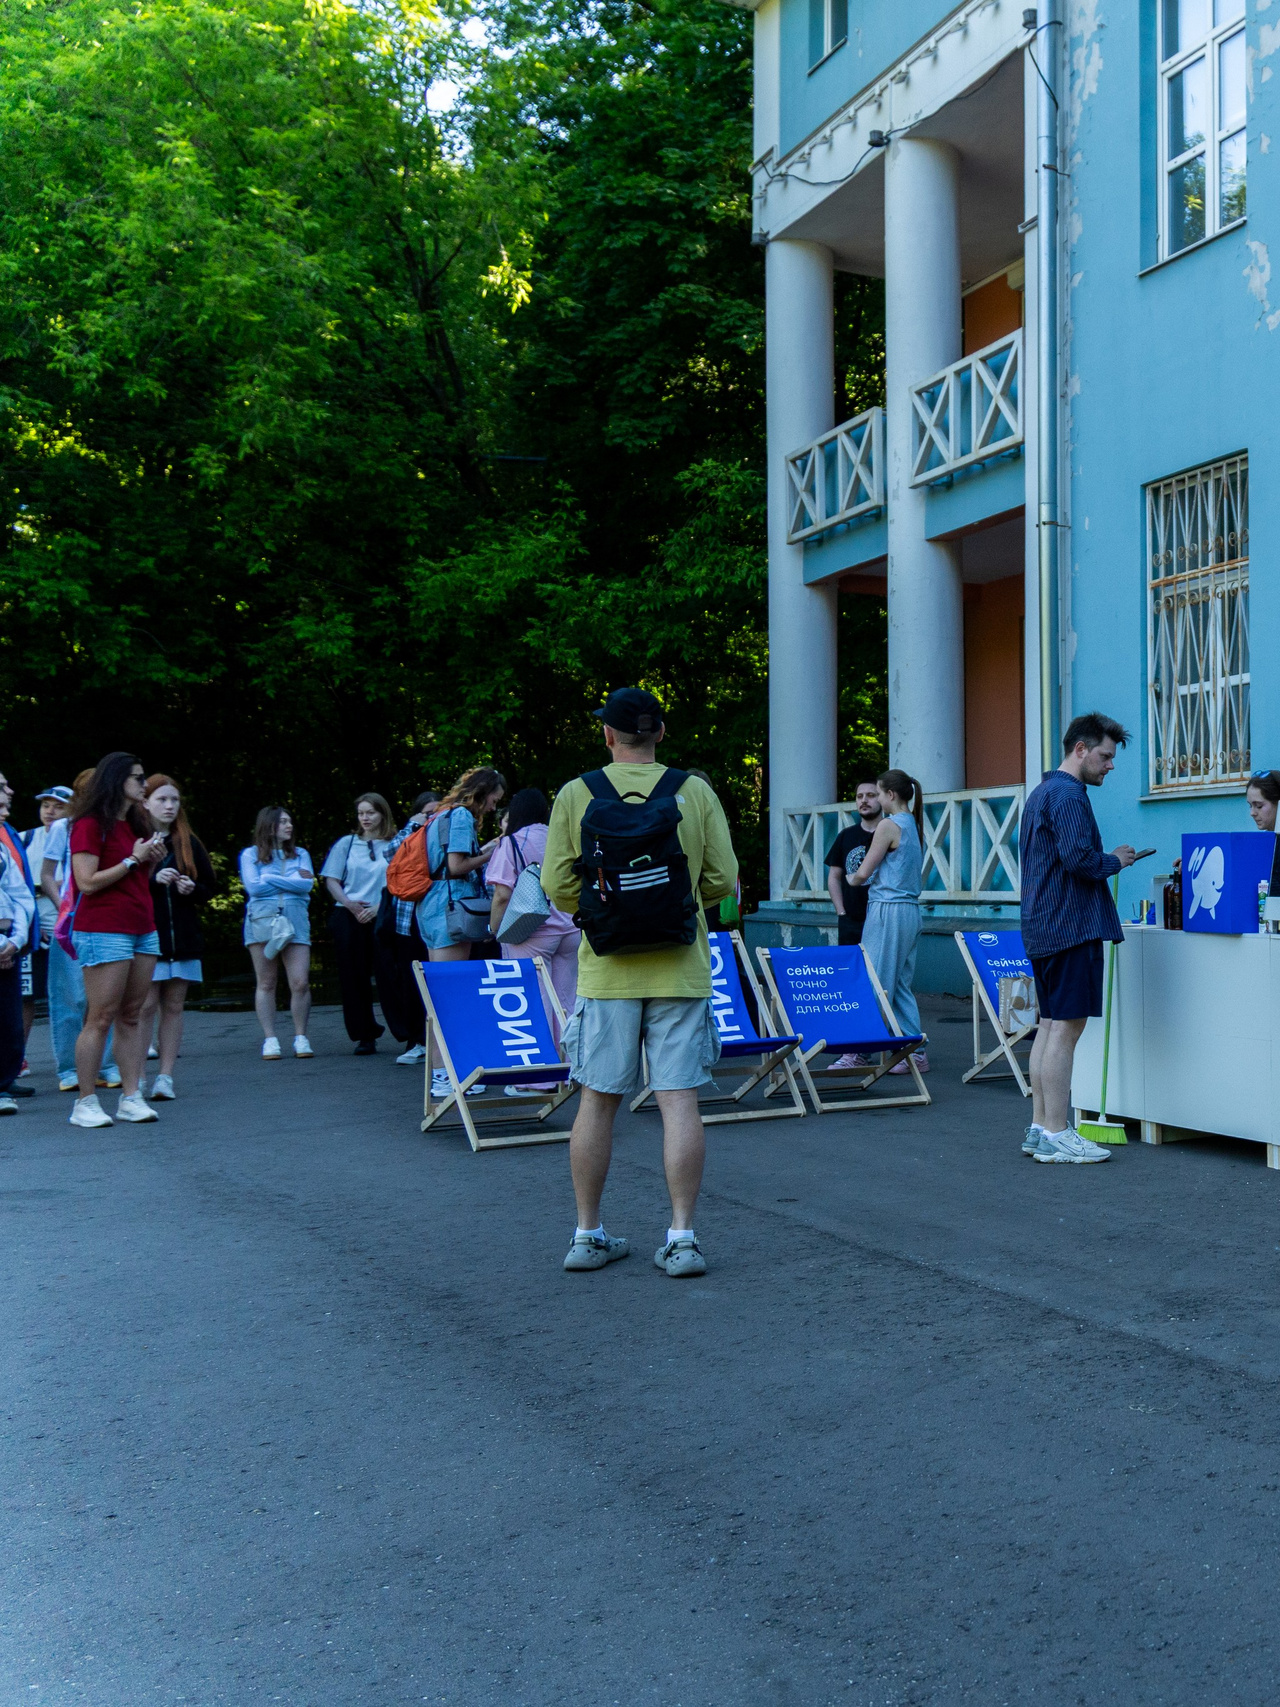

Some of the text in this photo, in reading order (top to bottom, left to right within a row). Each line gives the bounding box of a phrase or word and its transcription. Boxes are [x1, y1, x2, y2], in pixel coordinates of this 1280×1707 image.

[986, 957, 1030, 967] сейчас
[786, 965, 835, 976] сейчас
[990, 970, 1021, 978] точн
[788, 980, 828, 989] точно
[792, 991, 843, 1002] момент
[796, 1001, 860, 1015] для кофе
